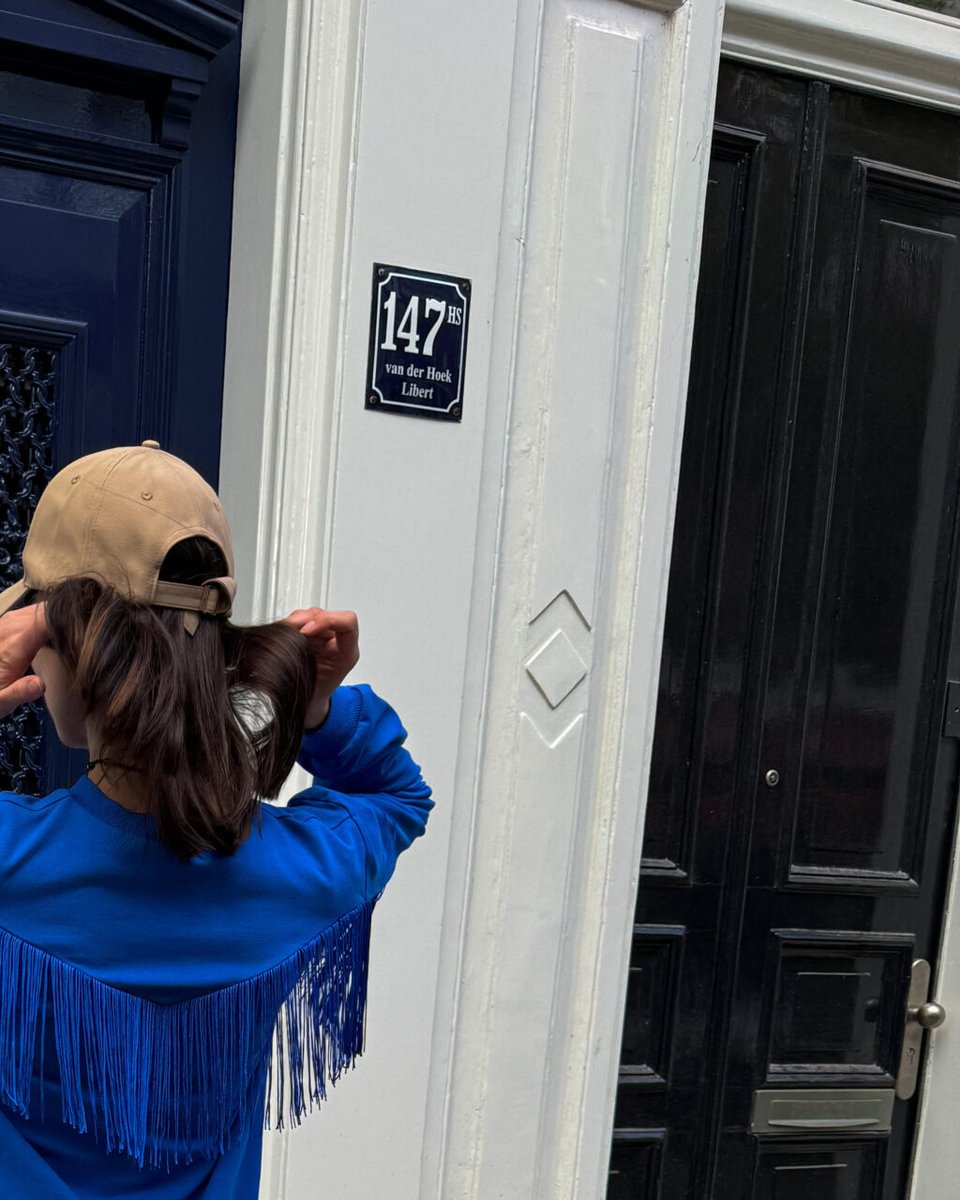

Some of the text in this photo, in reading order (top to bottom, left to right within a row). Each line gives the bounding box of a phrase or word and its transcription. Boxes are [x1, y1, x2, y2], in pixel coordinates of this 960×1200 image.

[380, 291, 462, 356] 147 HS
[385, 363, 452, 383] van der Hoek
[401, 382, 434, 399] Libert
